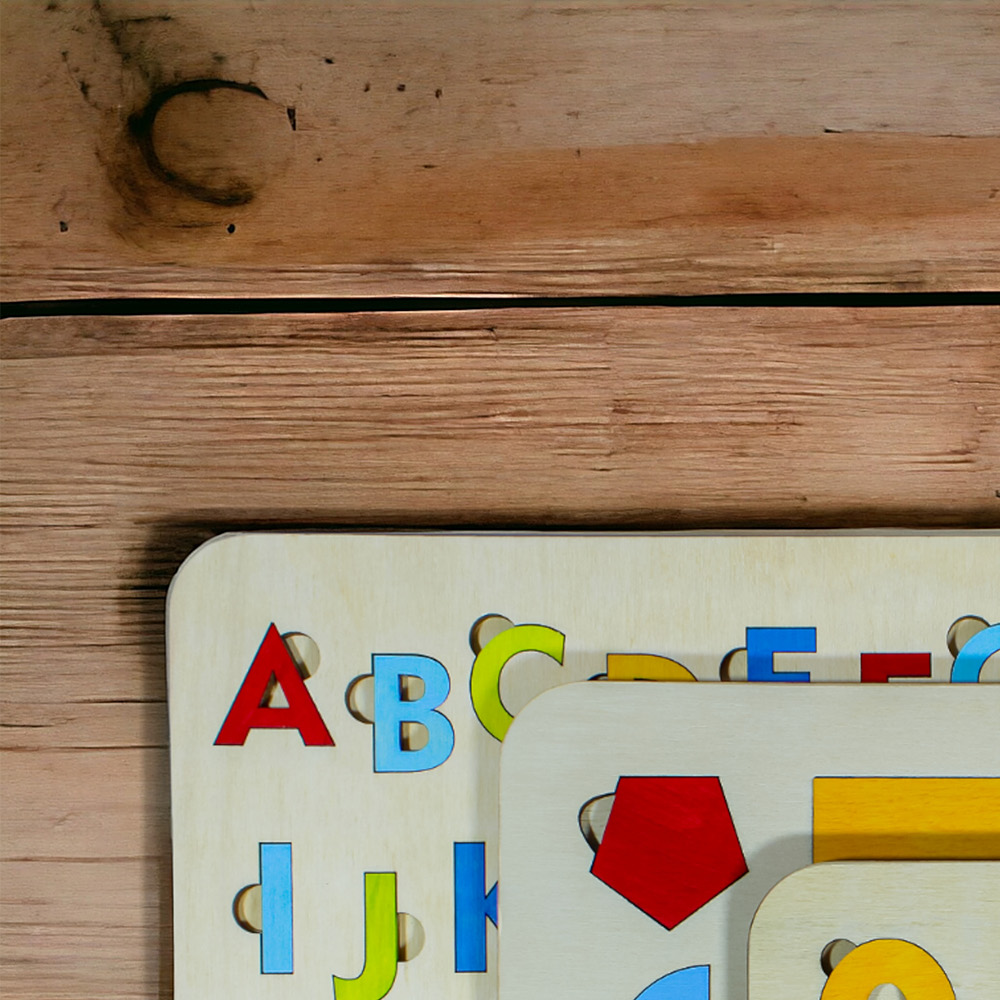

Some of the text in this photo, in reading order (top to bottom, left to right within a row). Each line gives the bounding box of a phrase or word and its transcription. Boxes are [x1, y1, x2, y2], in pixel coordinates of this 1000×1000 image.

[213, 622, 335, 747] A
[371, 653, 455, 773] B
[469, 623, 566, 743] C
